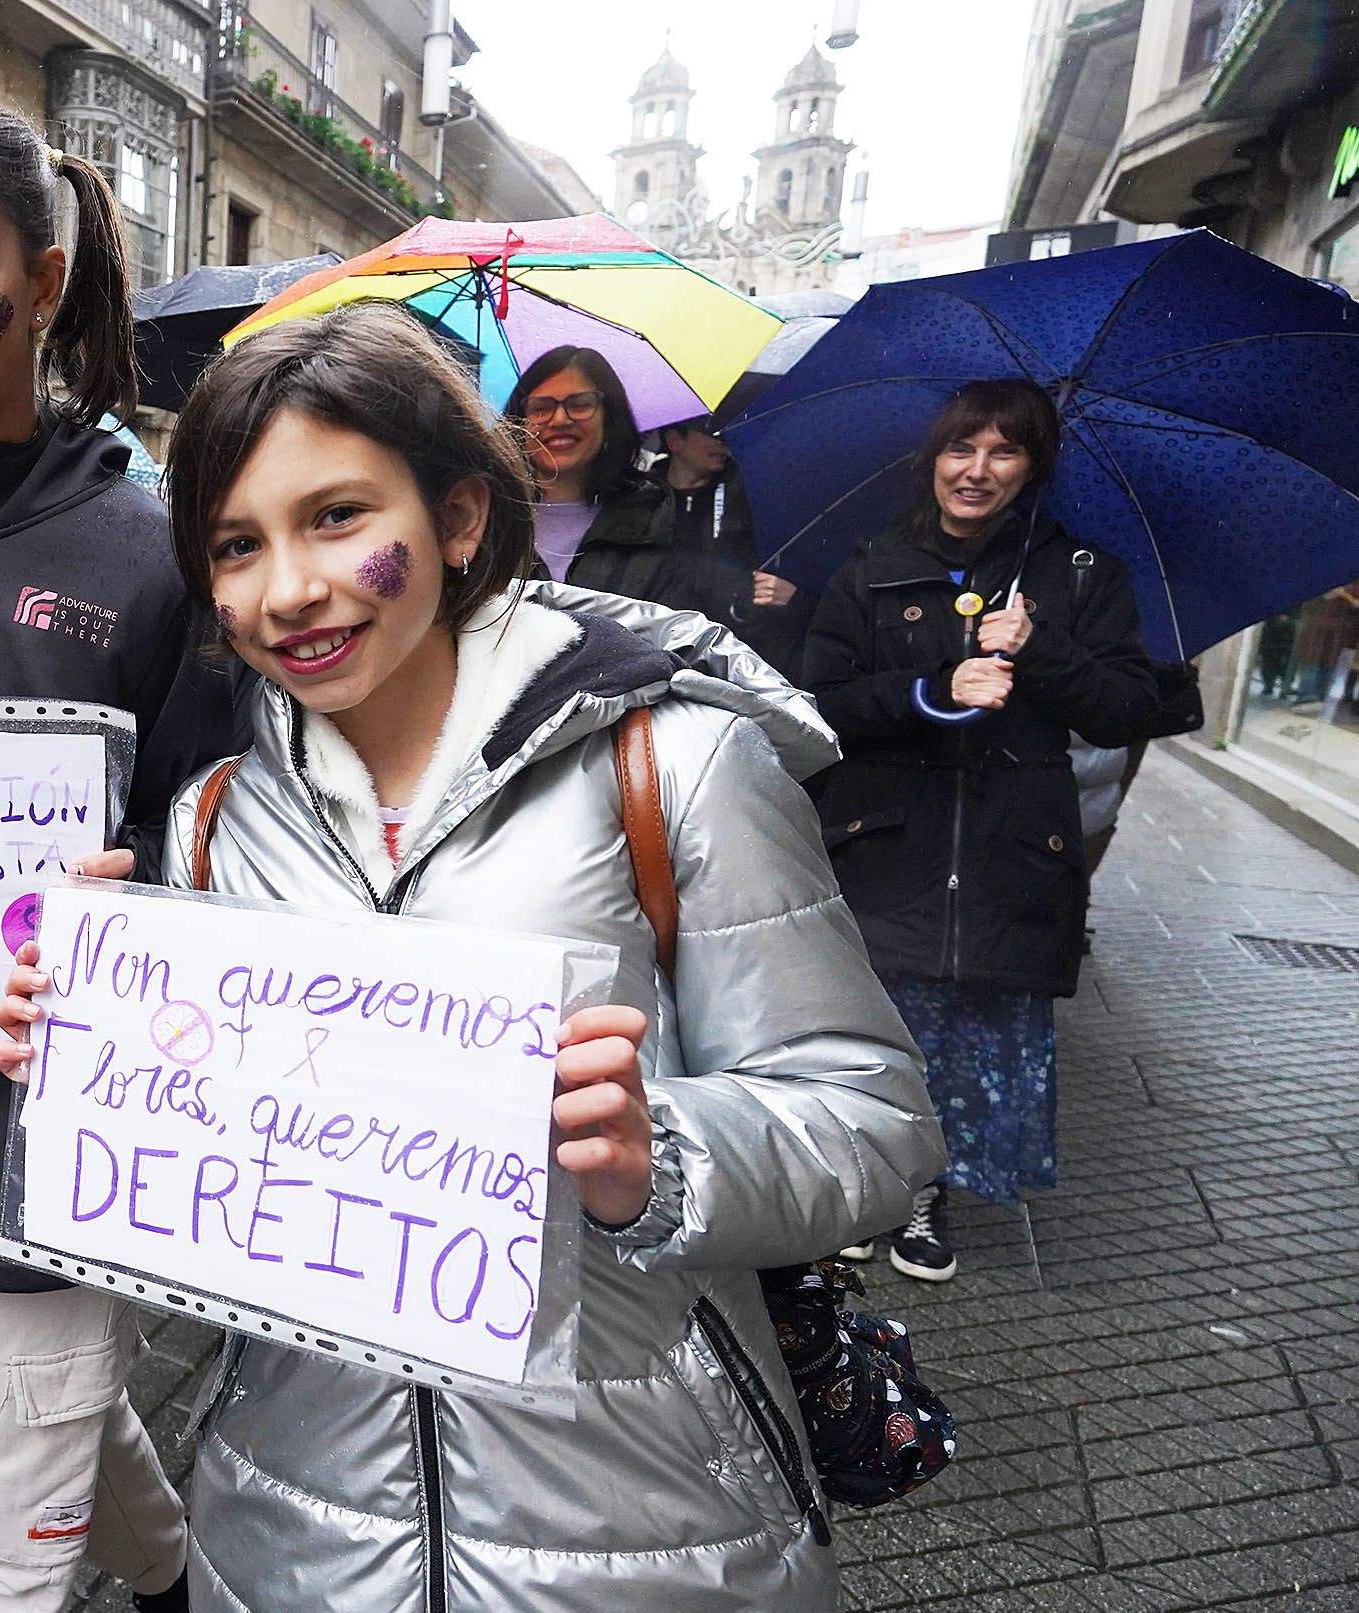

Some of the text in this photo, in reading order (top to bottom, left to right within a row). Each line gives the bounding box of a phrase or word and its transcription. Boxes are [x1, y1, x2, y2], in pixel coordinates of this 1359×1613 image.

[52, 621, 112, 648] THERE
[54, 608, 115, 635] IS OUT
[58, 596, 119, 622] ADVENTURE
[51, 911, 558, 1070] Non queremos
[35, 1010, 549, 1221] Flores, queremos
[71, 1127, 538, 1342] DEREITOS
